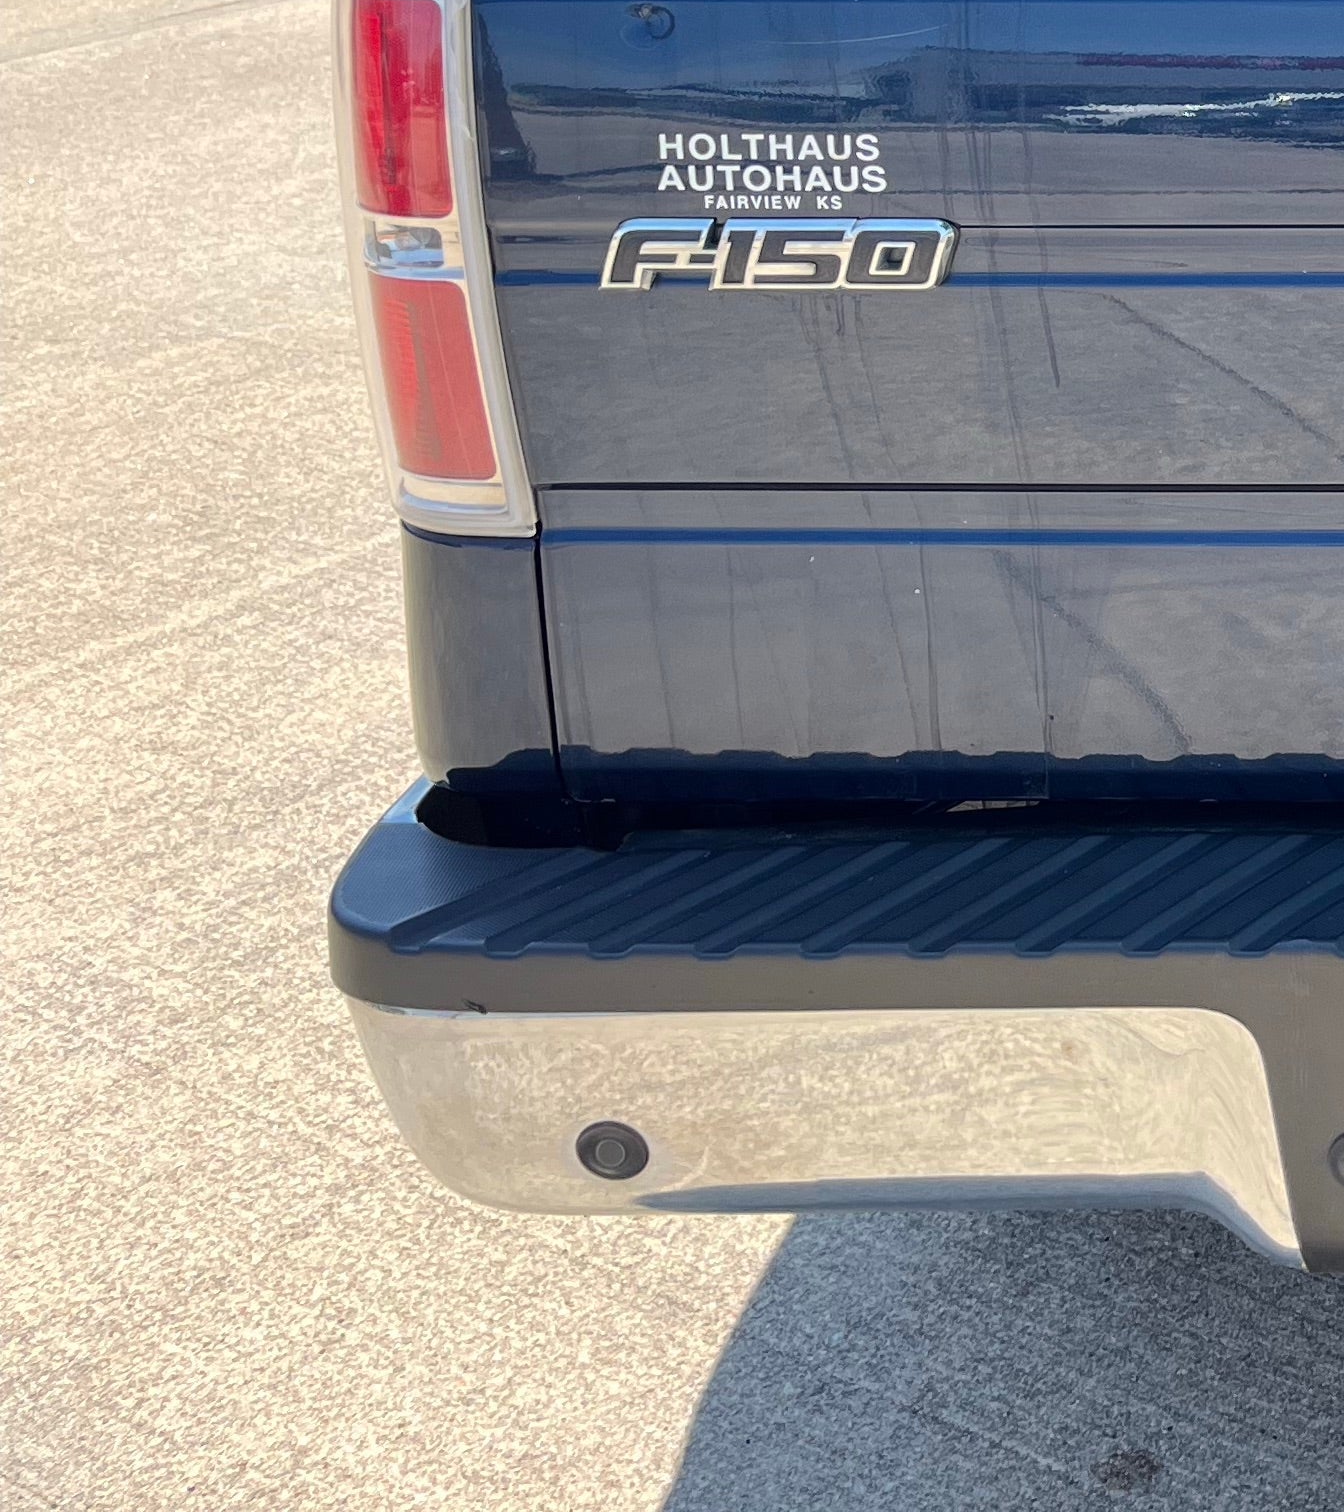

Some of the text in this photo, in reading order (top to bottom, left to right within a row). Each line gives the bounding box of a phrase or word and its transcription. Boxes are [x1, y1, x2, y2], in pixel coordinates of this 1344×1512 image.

[658, 133, 880, 161] HOLTHAUS
[658, 165, 888, 192] AUTOHAUS
[704, 195, 843, 210] FAIRVIEW KS
[599, 216, 961, 290] F-150
